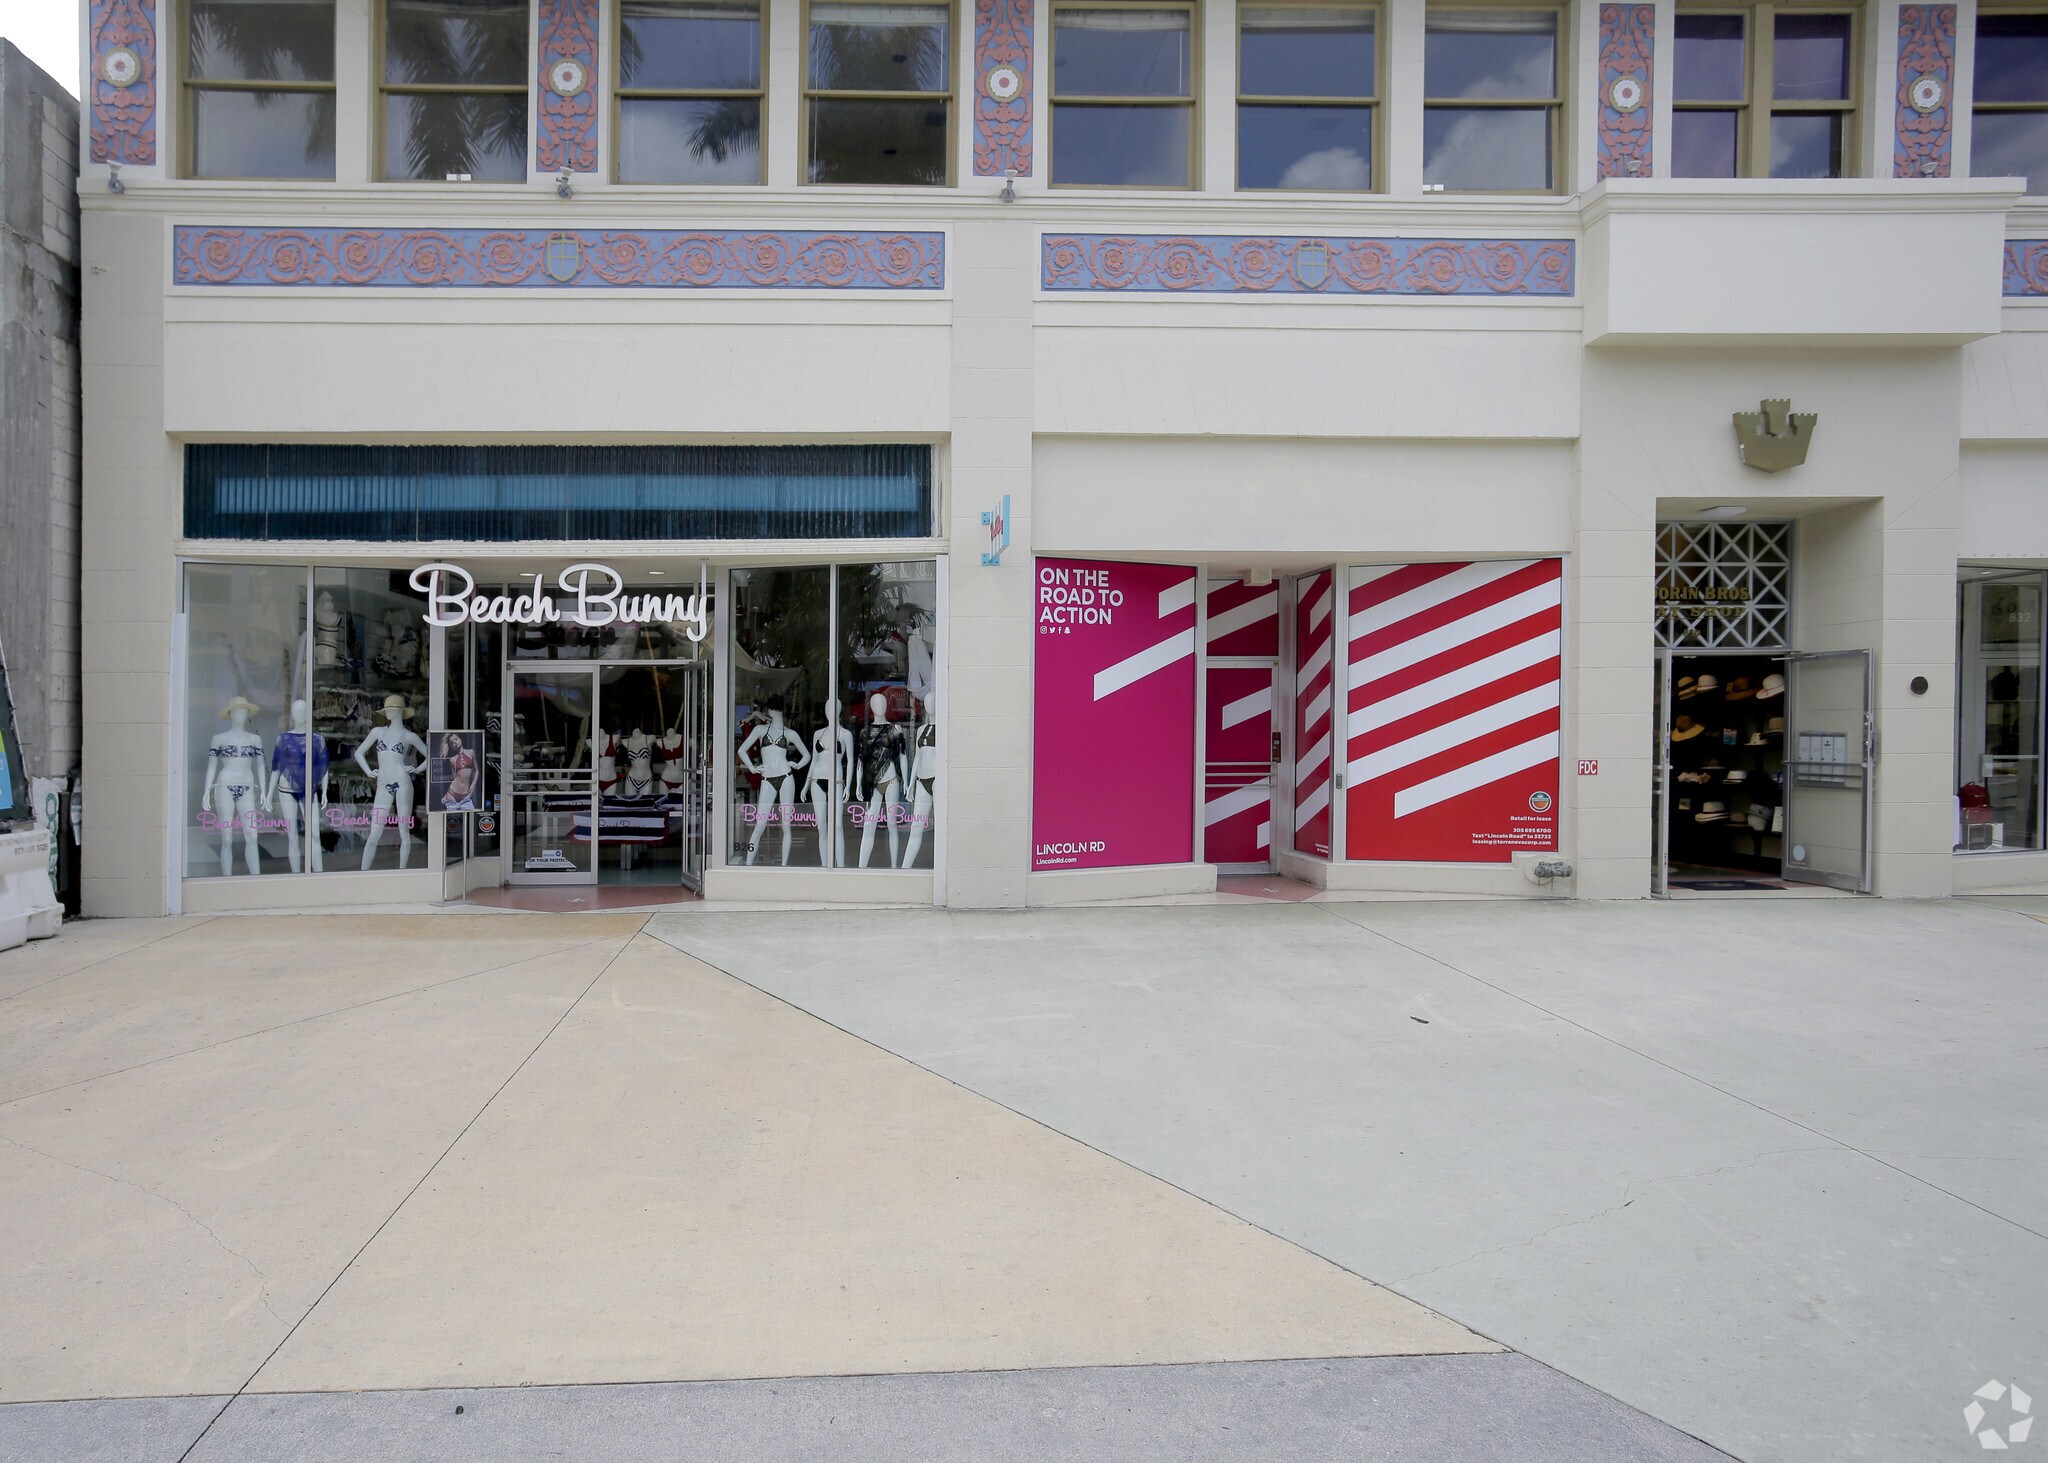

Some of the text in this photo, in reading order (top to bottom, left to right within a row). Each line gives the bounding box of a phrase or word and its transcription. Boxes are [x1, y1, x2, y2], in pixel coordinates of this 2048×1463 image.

[1040, 567, 1109, 587] ON THE
[409, 563, 707, 642] Beach Bunny
[1040, 587, 1124, 607] ROAD TO
[1040, 606, 1112, 625] ACTION
[1656, 606, 1746, 617] AT SHOP
[2009, 612, 2031, 623] 832
[1579, 760, 1597, 775] FDC
[196, 810, 292, 833] Beach Bunny
[325, 807, 415, 829] Beach Bunny
[740, 803, 818, 827] Beach Bunny
[847, 804, 930, 829] Beach Bunny
[733, 842, 755, 853] 826
[1036, 841, 1105, 855] LINCOLN RD
[1036, 857, 1077, 865] LincolnRd.com
